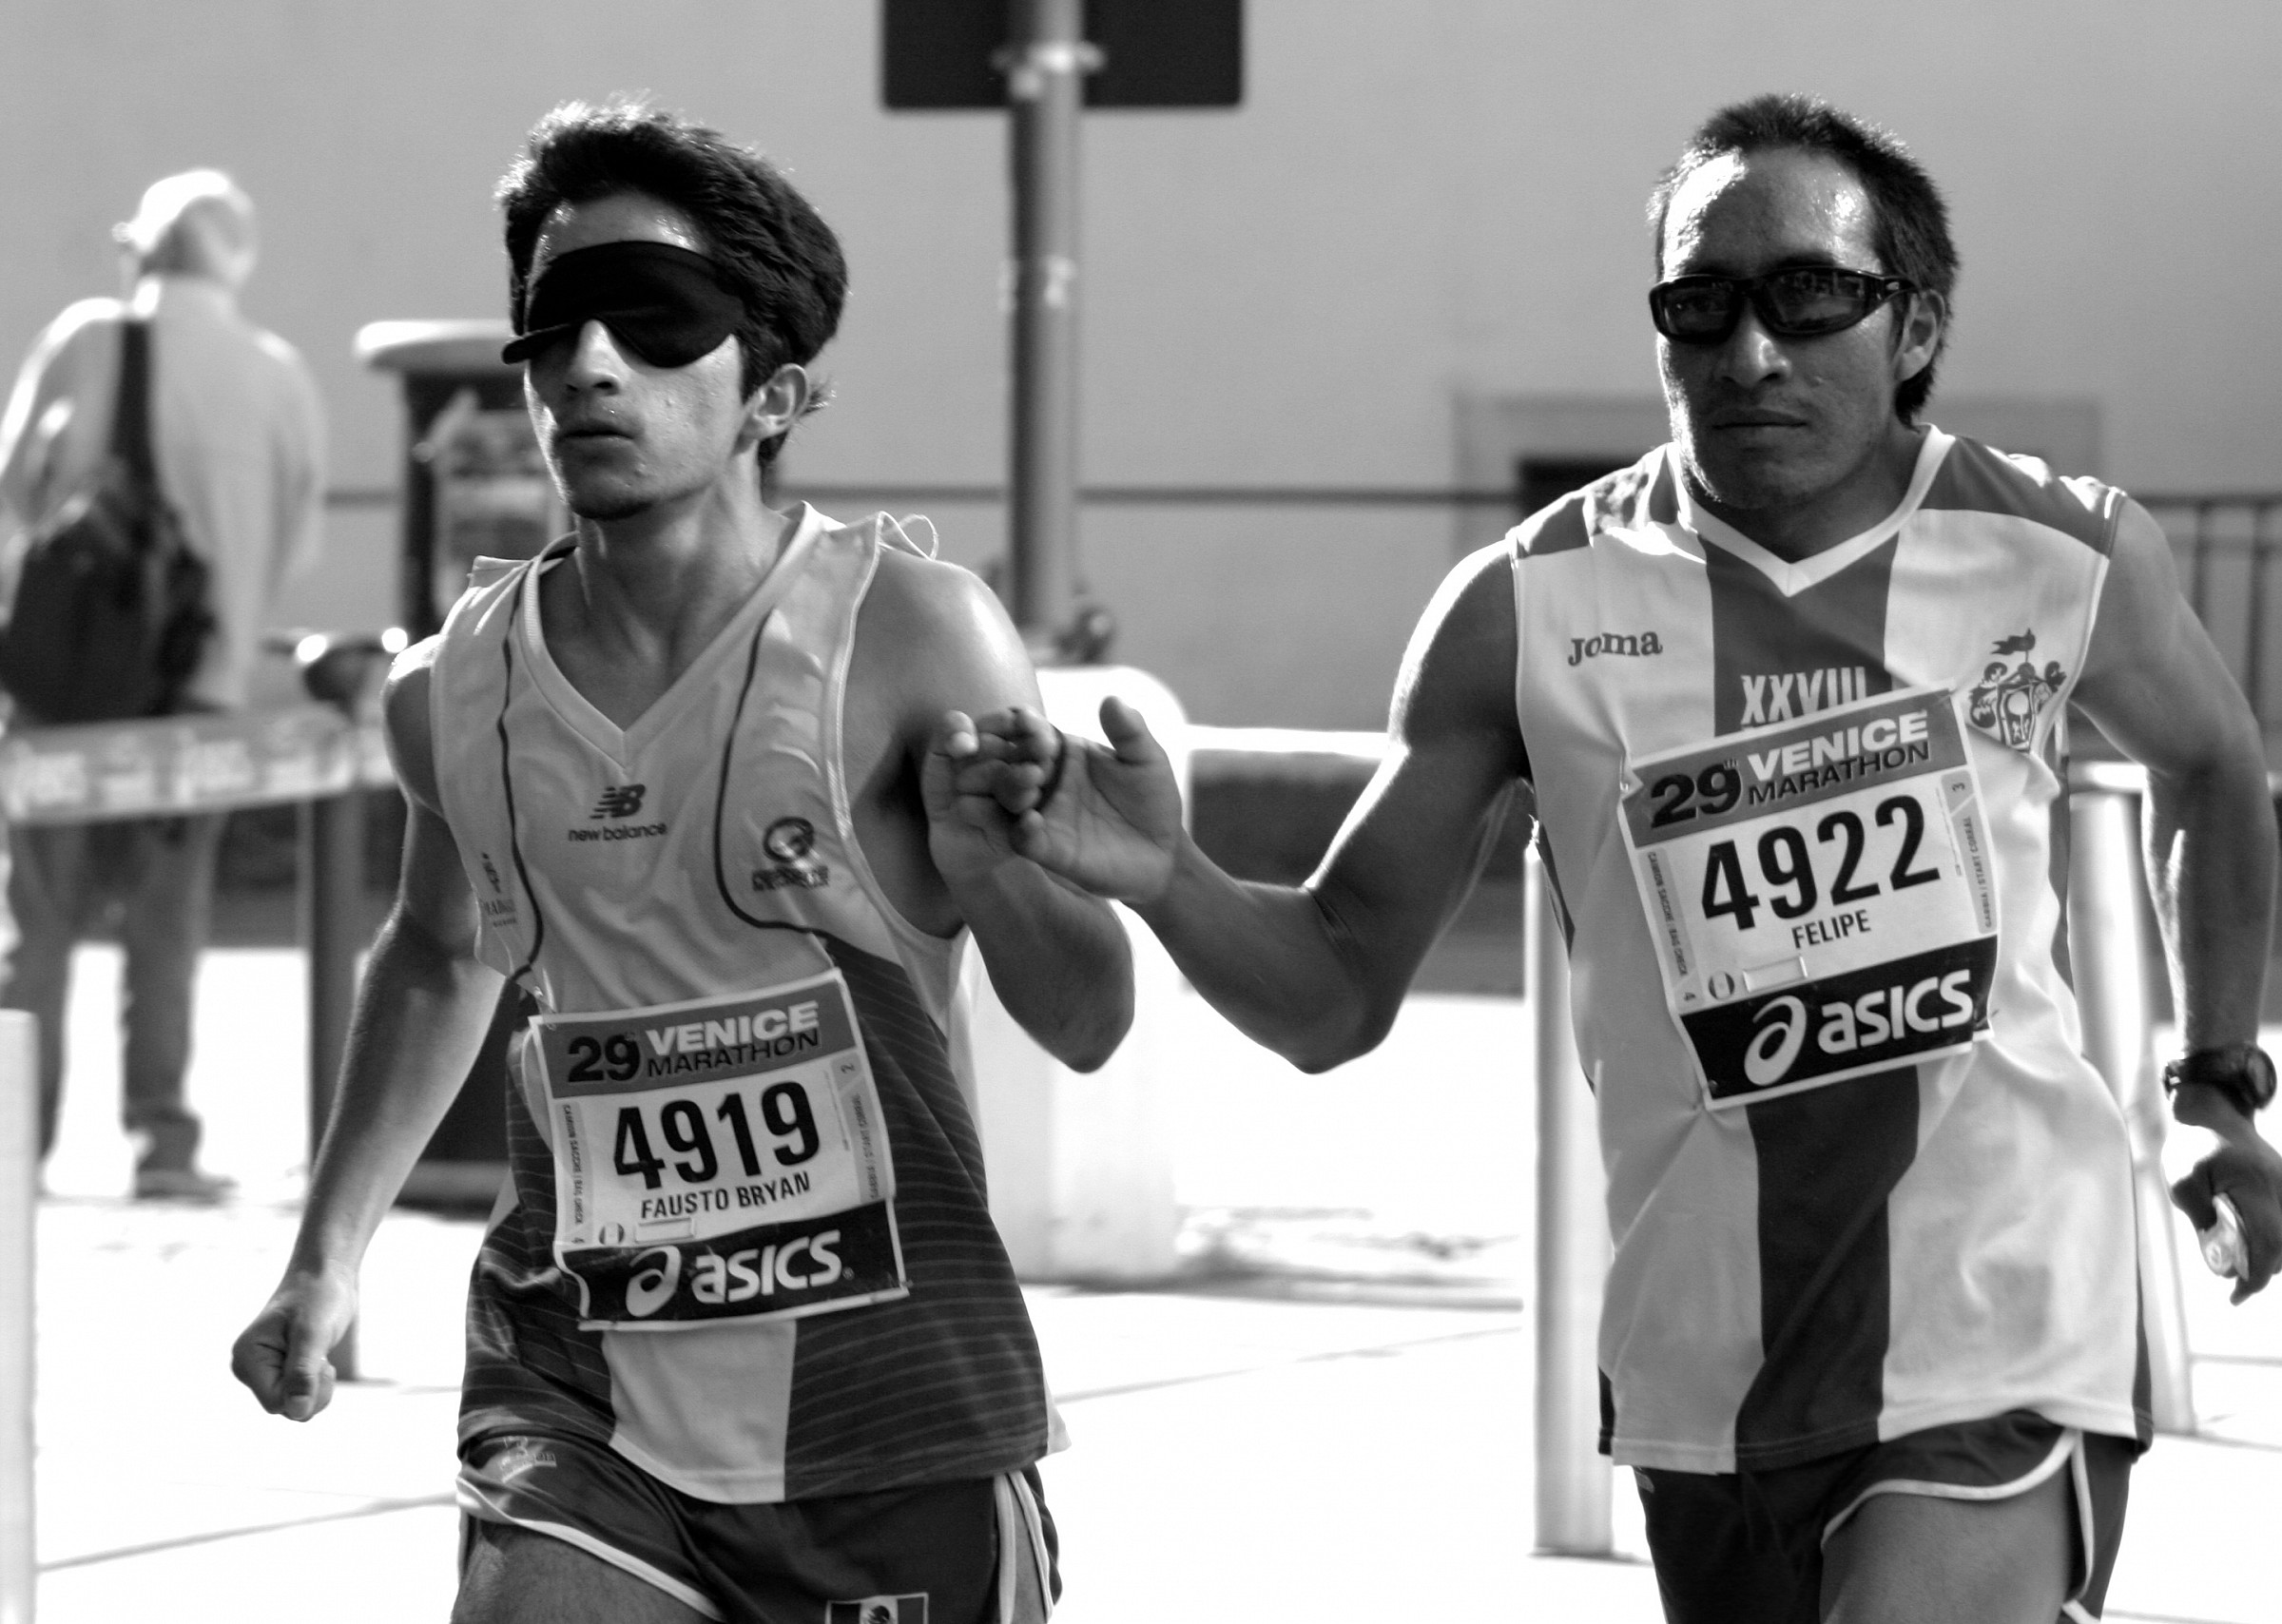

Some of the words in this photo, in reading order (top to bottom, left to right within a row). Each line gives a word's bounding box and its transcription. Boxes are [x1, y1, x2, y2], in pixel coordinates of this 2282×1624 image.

[1568, 630, 1663, 666] Joma
[1741, 666, 1866, 727] XXVIII
[1651, 764, 1742, 829] 29
[1748, 710, 1929, 781] VENICE
[1749, 741, 1930, 805] MARATHON
[568, 828, 600, 842] new
[602, 823, 667, 841] balance
[1702, 795, 1941, 931] 4922
[1791, 910, 1871, 948] FELIPE
[568, 1034, 641, 1083] 29
[646, 1000, 820, 1056] VENICE
[1818, 969, 1974, 1054] asics
[648, 1028, 820, 1078] MARATHON
[613, 1081, 821, 1190] 4919
[641, 1189, 729, 1219] FAUSTO
[738, 1170, 811, 1208] BRYAN
[691, 1229, 841, 1305] asics
